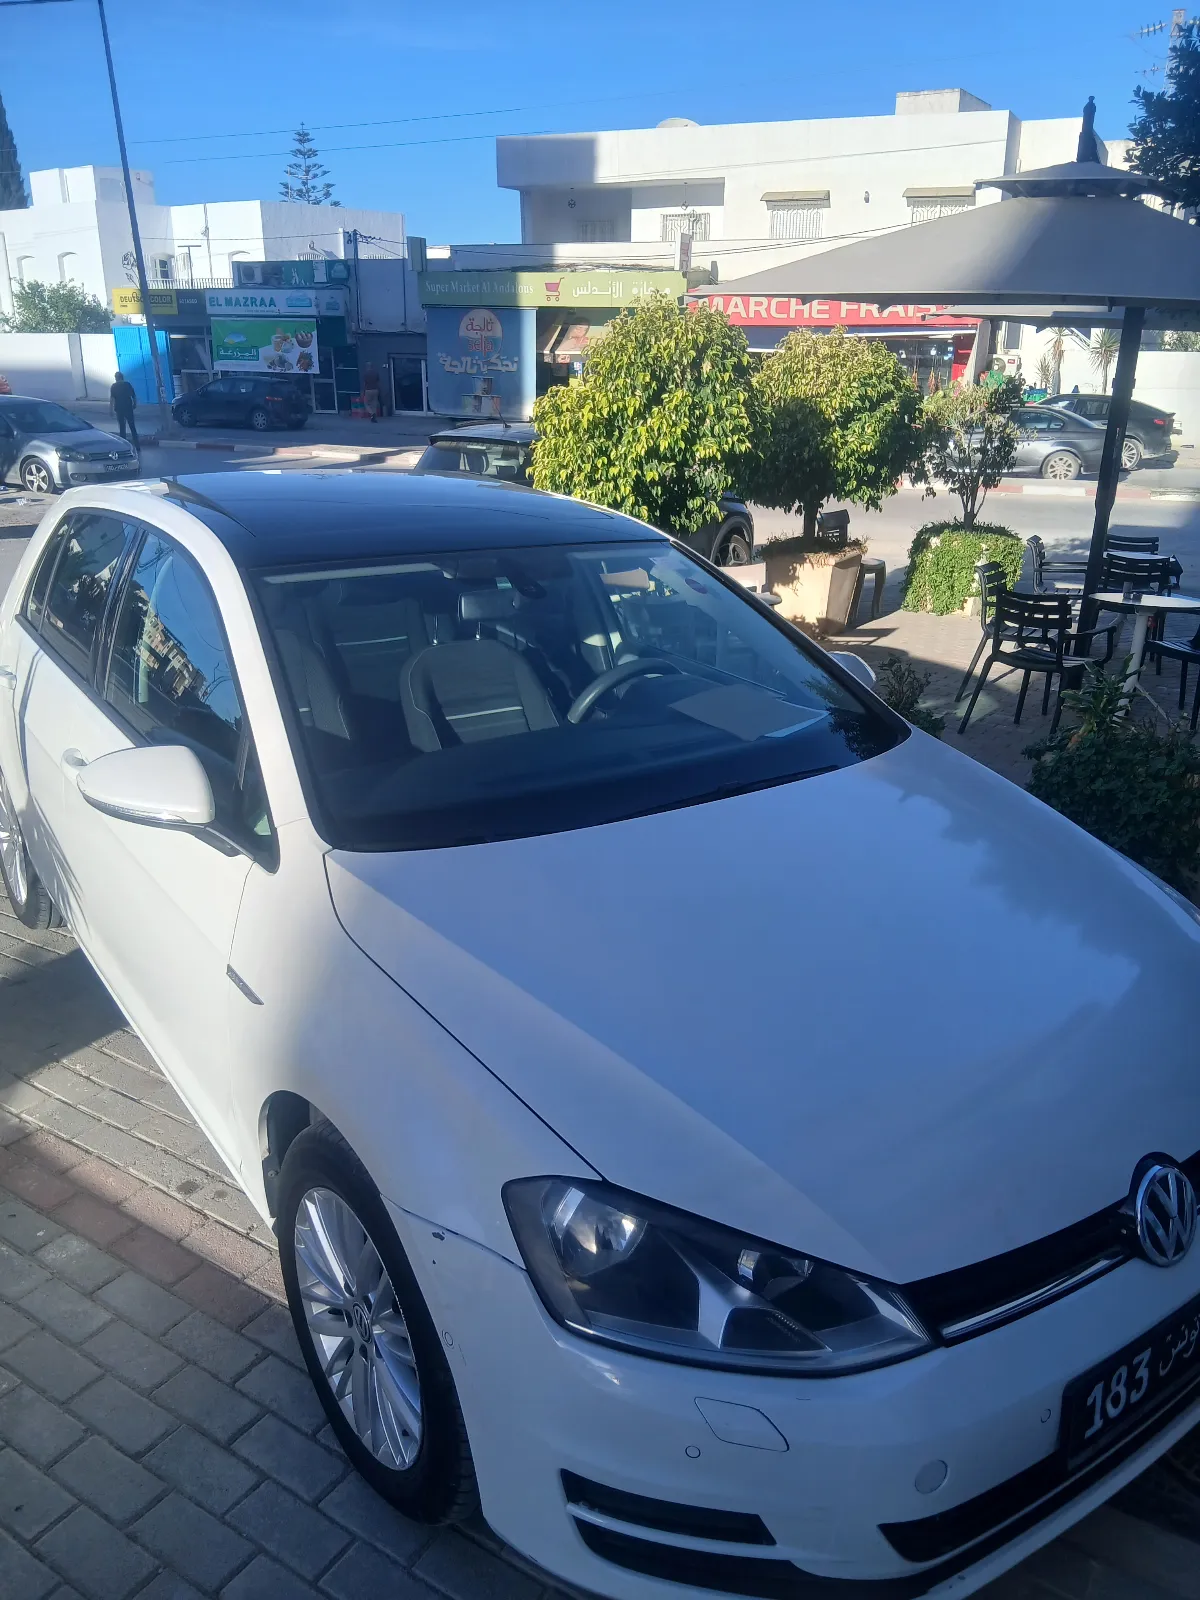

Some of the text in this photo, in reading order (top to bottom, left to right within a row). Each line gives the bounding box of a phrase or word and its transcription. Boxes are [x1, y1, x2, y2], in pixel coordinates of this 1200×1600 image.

[425, 281, 449, 295] Super
[450, 281, 479, 293] Market
[492, 281, 534, 294] Andalous
[208, 296, 277, 308] EL MAZRAA
[466, 316, 494, 335] ثالجة
[1084, 1347, 1152, 1440] 183
